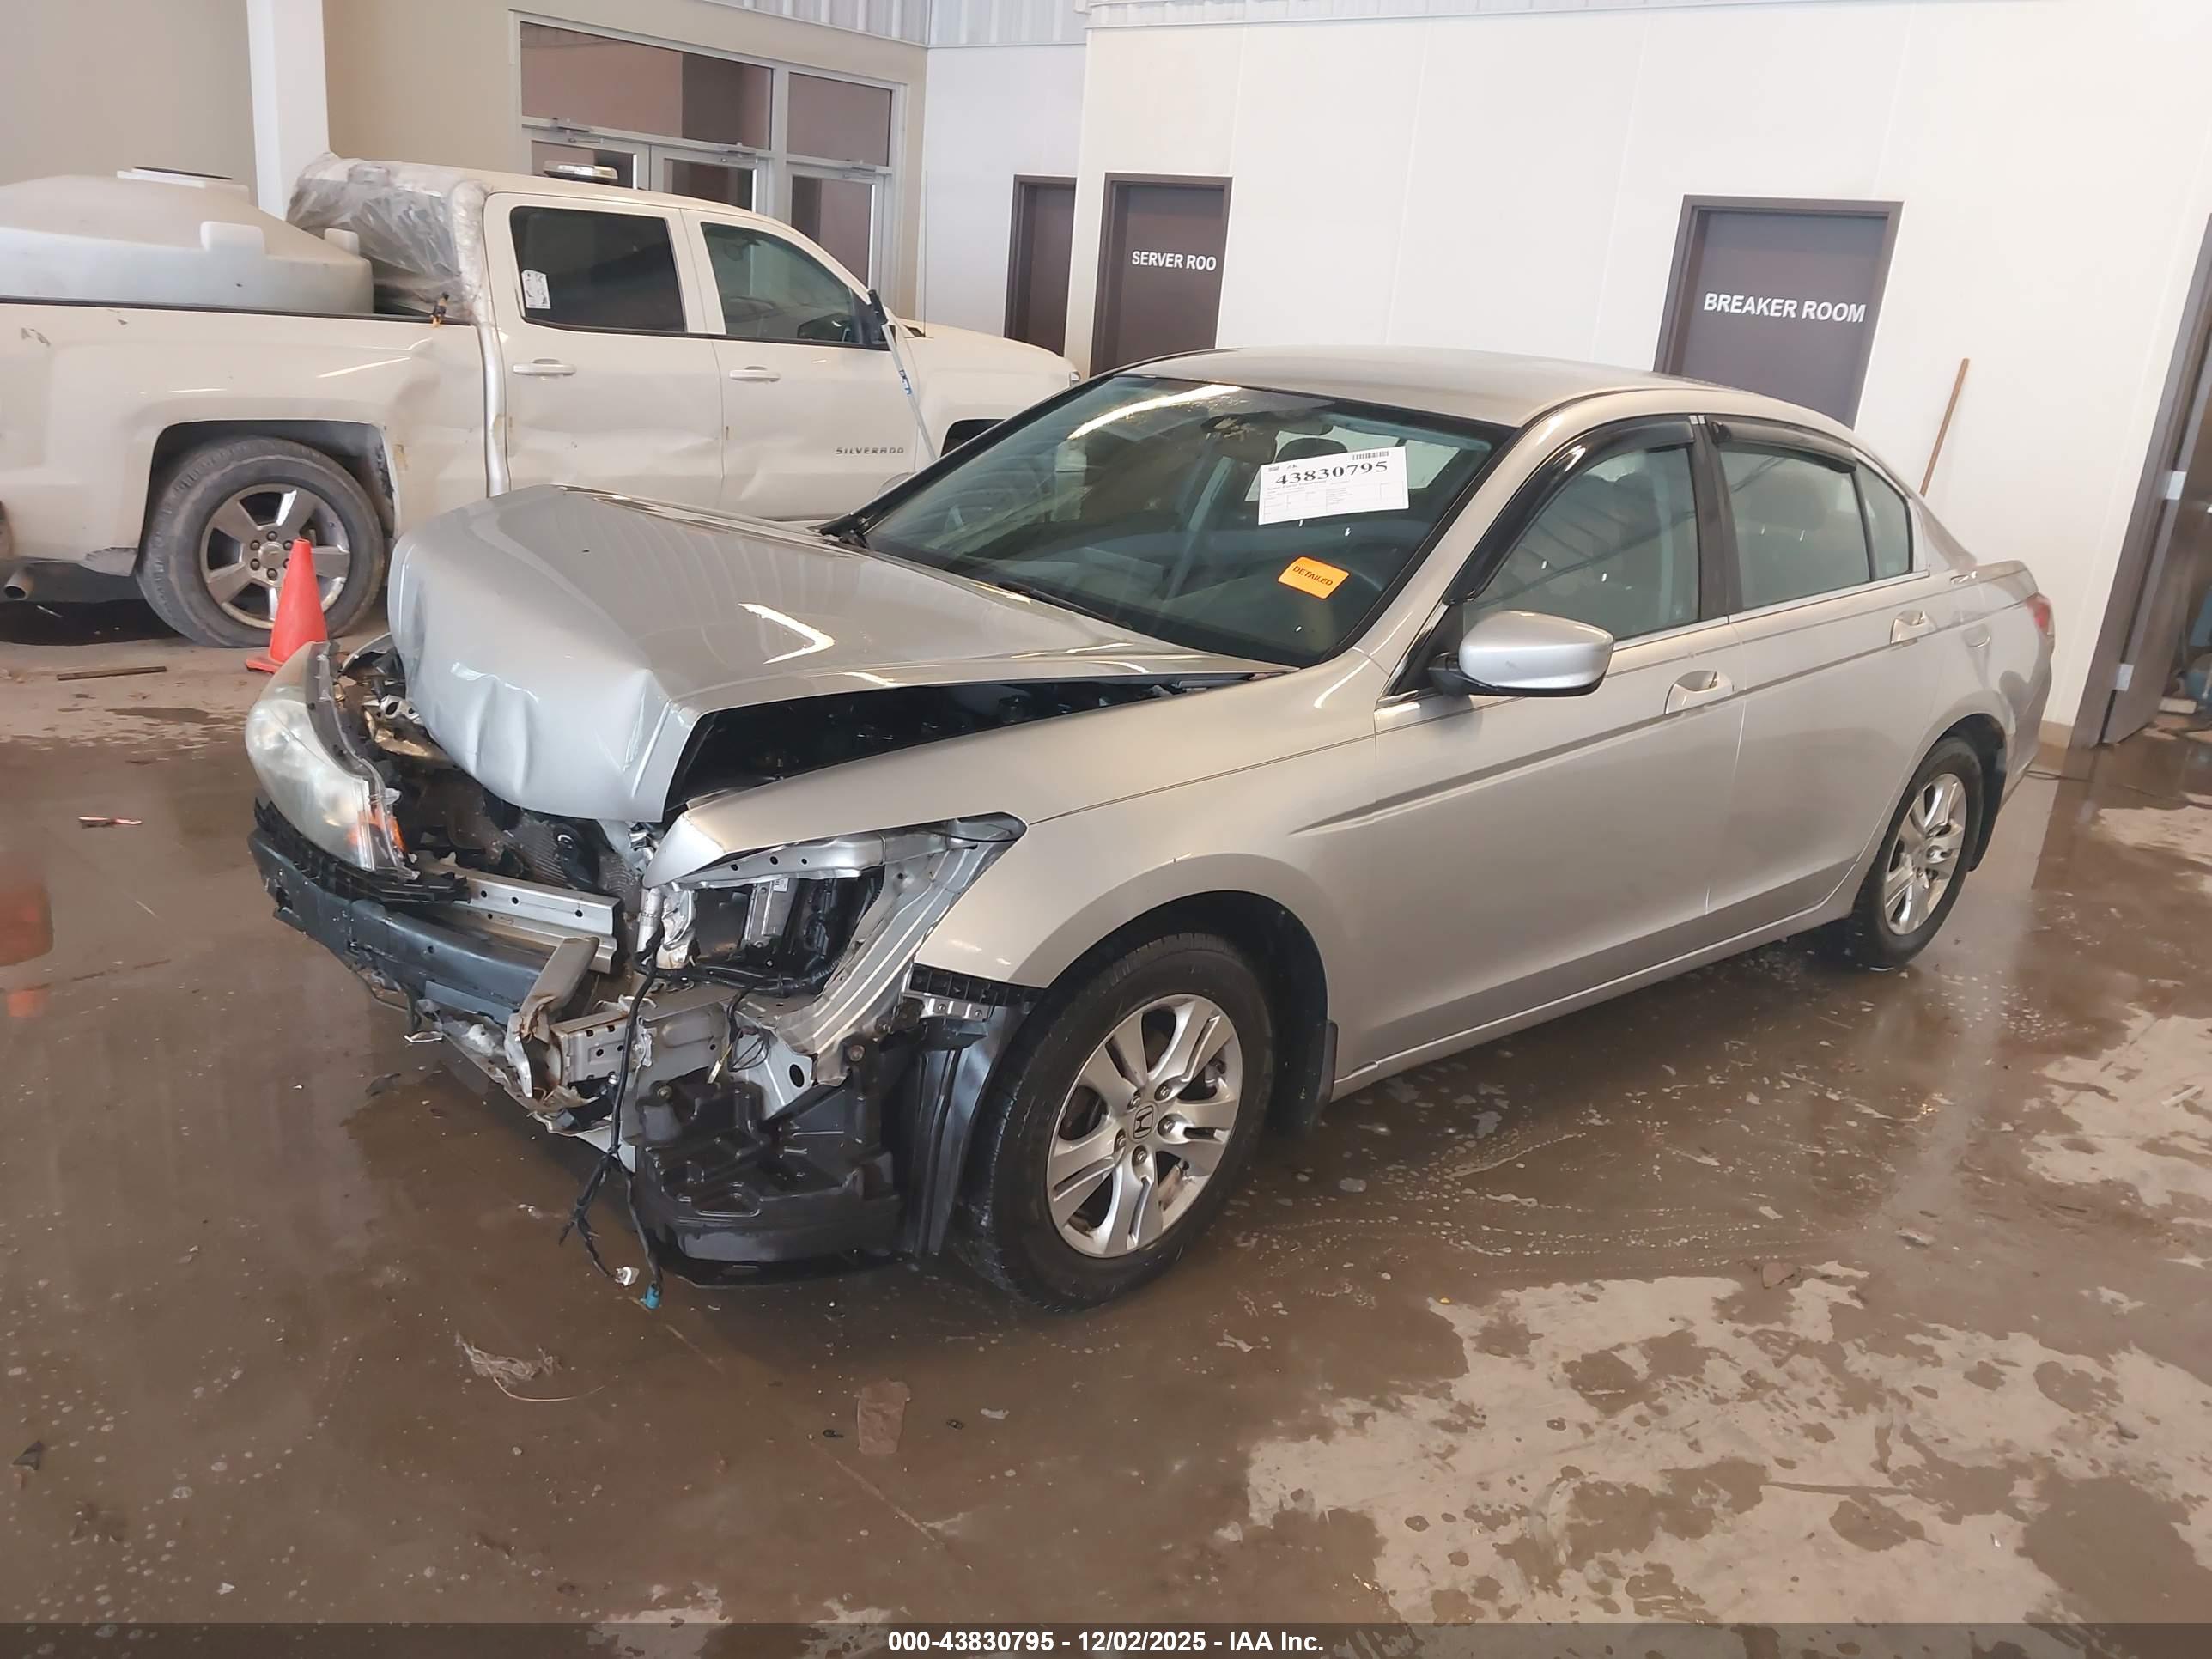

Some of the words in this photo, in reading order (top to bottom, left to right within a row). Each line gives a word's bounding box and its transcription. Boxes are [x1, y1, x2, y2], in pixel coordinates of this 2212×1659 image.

[1132, 251, 1184, 269] SERVER
[1186, 254, 1217, 271] ROO
[1704, 293, 1797, 318] BREAKER
[1802, 301, 1866, 323] ROOM
[1275, 460, 1388, 485] 43830795
[1292, 565, 1334, 586] DETAILED
